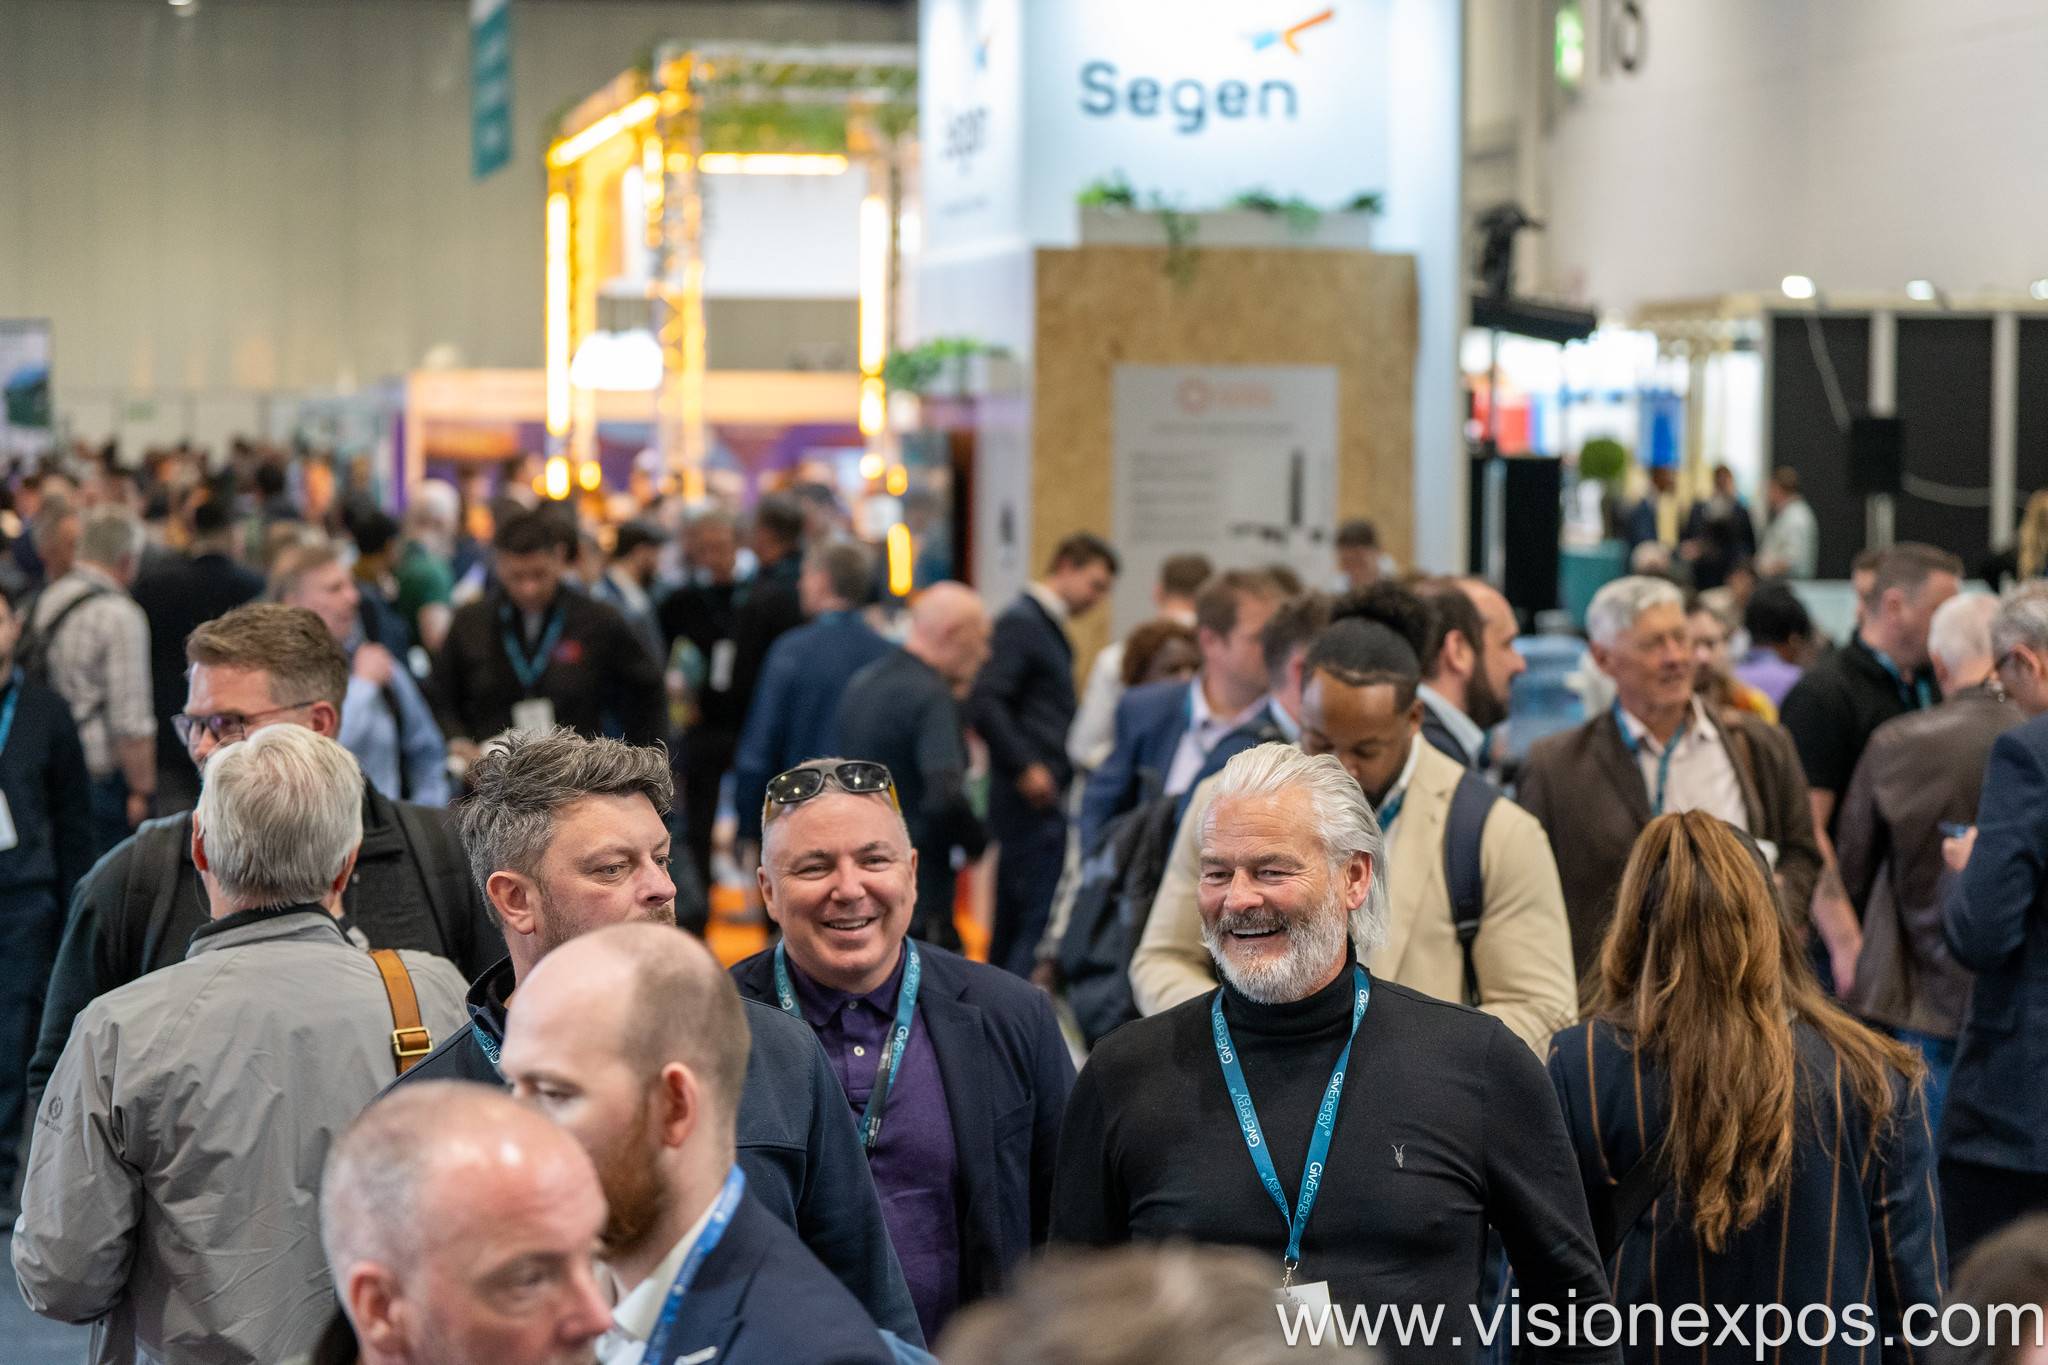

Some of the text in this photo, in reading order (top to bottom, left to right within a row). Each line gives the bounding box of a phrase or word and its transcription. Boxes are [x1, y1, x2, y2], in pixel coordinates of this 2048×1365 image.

[1079, 59, 1299, 135] Segen
[1235, 1092, 1260, 1148] GivEnergy
[1318, 1071, 1344, 1132] GivEnergy
[1297, 1162, 1323, 1223] GivEnergy
